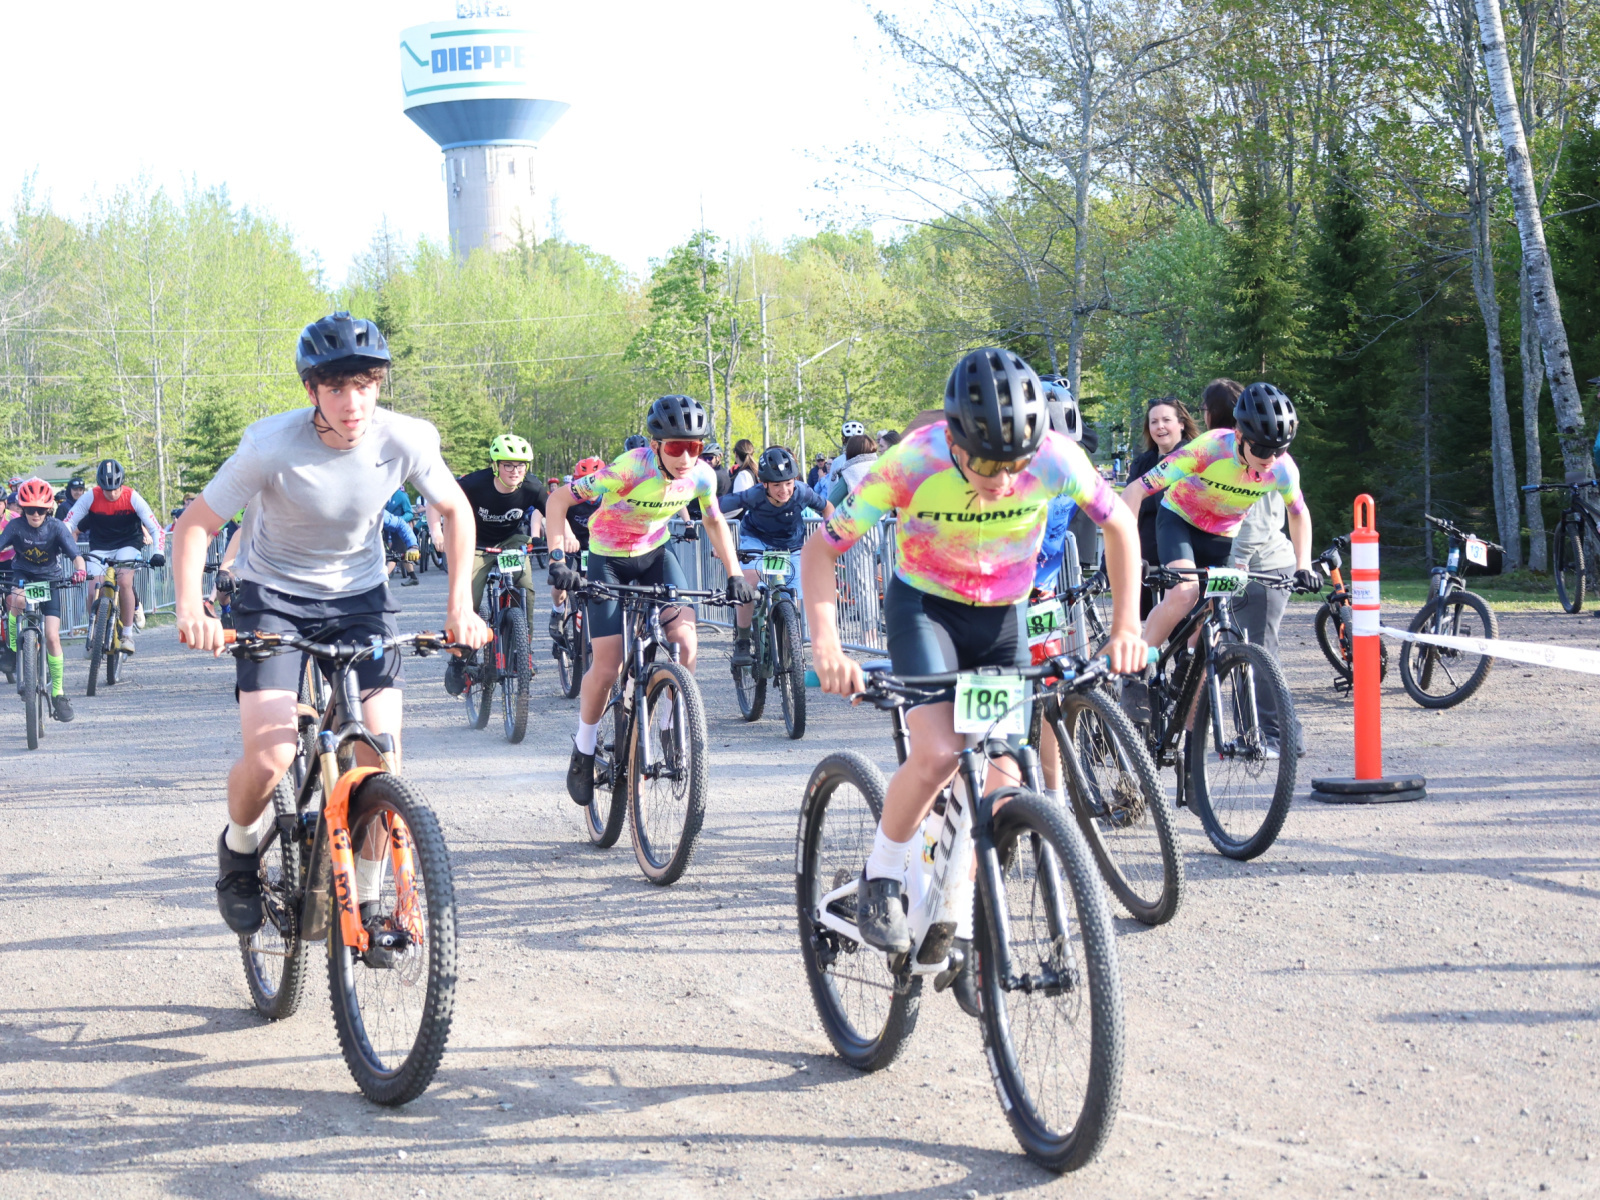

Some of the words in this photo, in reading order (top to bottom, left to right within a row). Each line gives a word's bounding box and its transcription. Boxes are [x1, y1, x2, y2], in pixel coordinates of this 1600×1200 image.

[431, 46, 526, 74] DIEPPE
[917, 504, 1039, 523] FITWORKS
[27, 586, 45, 599] 185
[1211, 576, 1239, 592] 189
[1027, 610, 1054, 637] 87
[963, 687, 1009, 720] 186
[335, 872, 354, 914] FOX
